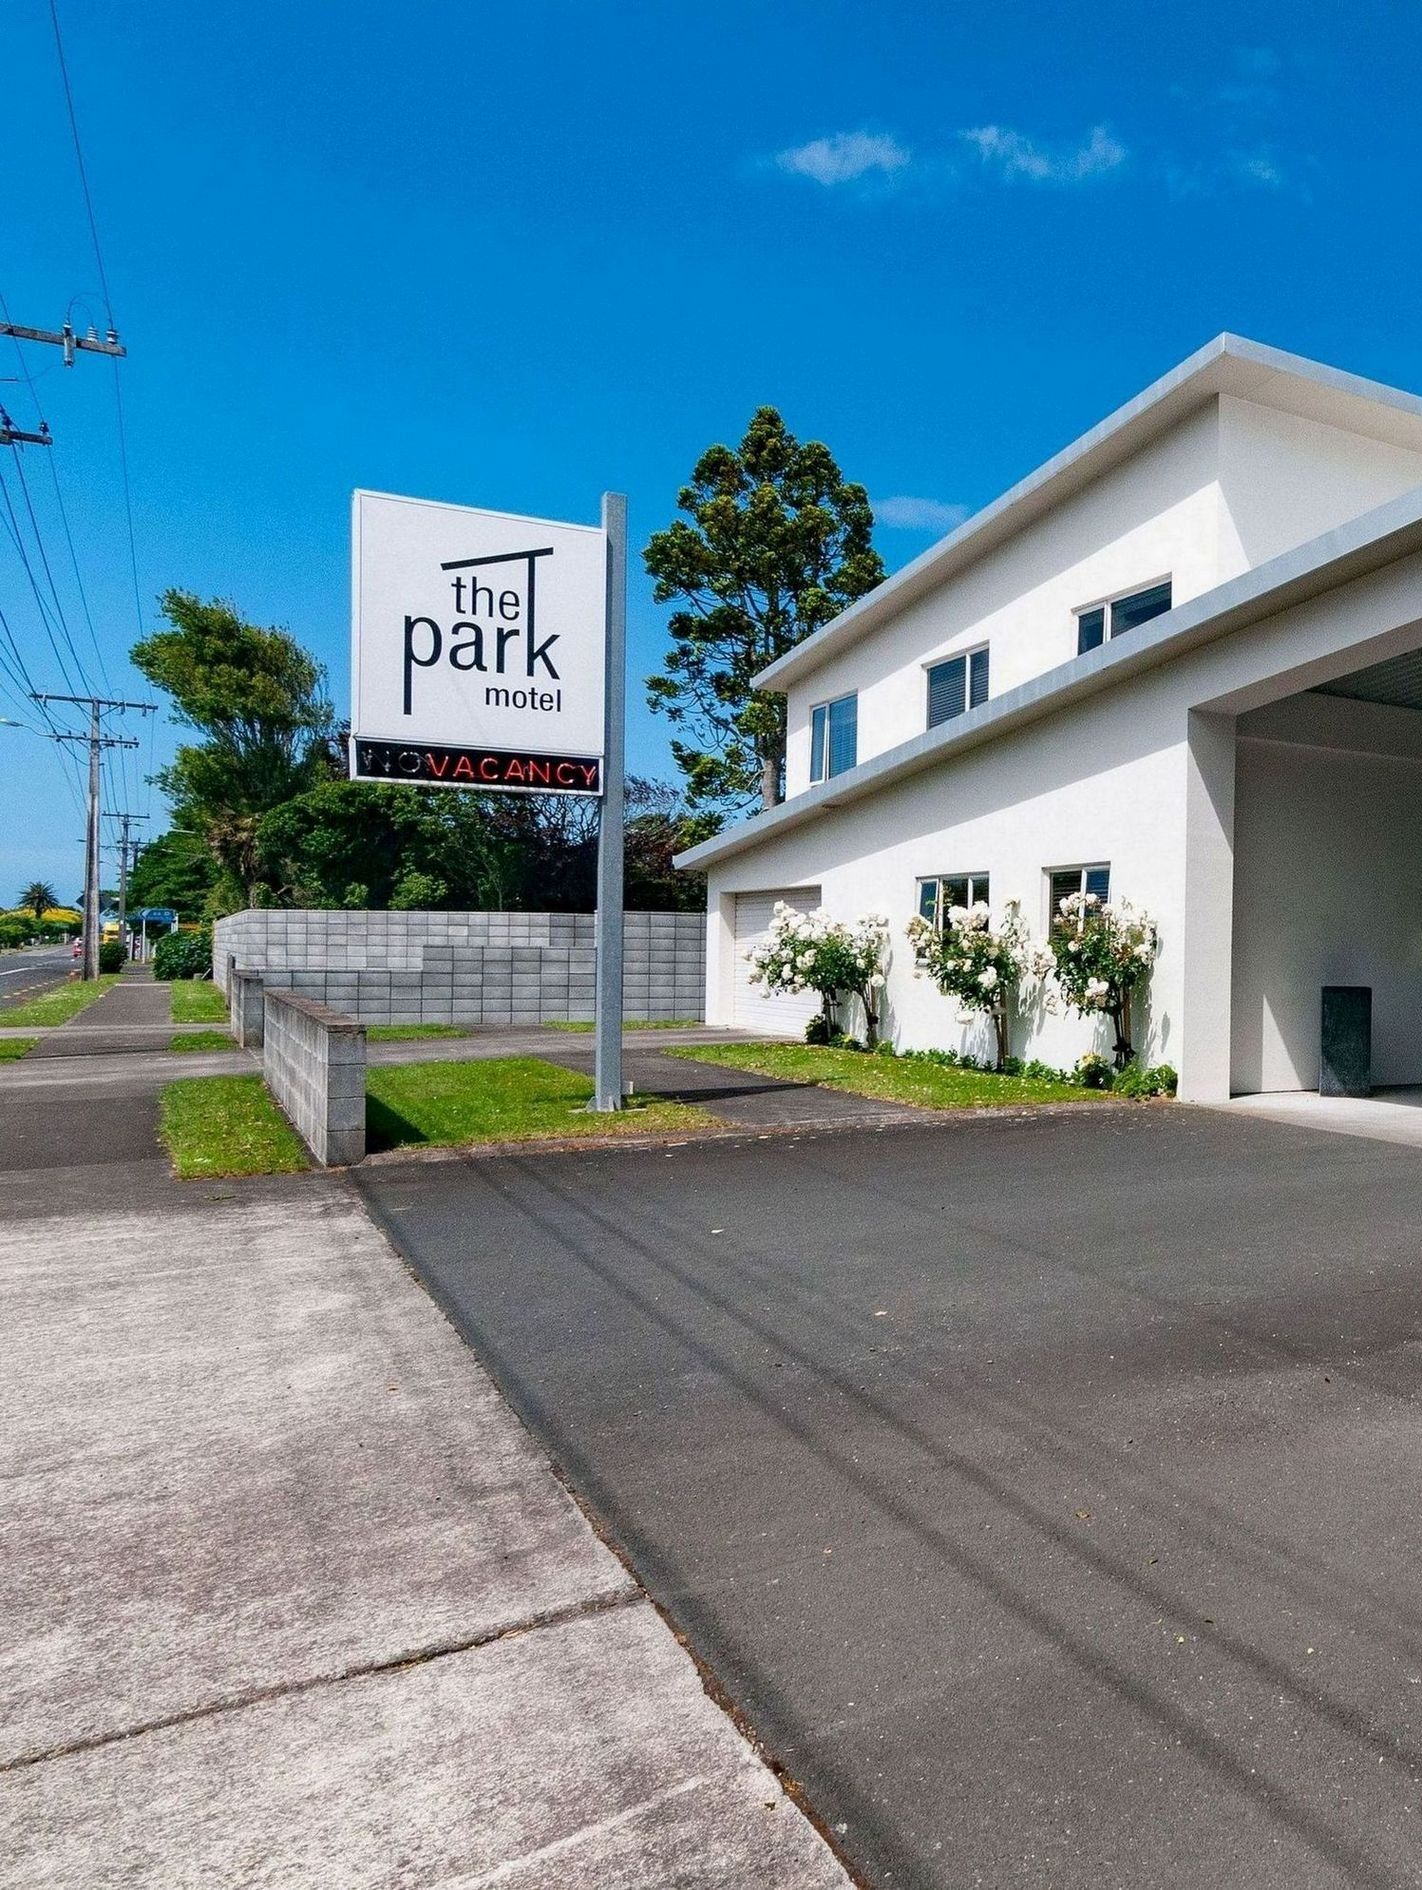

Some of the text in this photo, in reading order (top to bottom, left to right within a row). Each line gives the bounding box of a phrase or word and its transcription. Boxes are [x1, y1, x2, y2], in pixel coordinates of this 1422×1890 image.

[451, 576, 520, 621] the
[403, 553, 561, 716] park
[485, 686, 562, 713] motel
[426, 753, 597, 786] VACANCY
